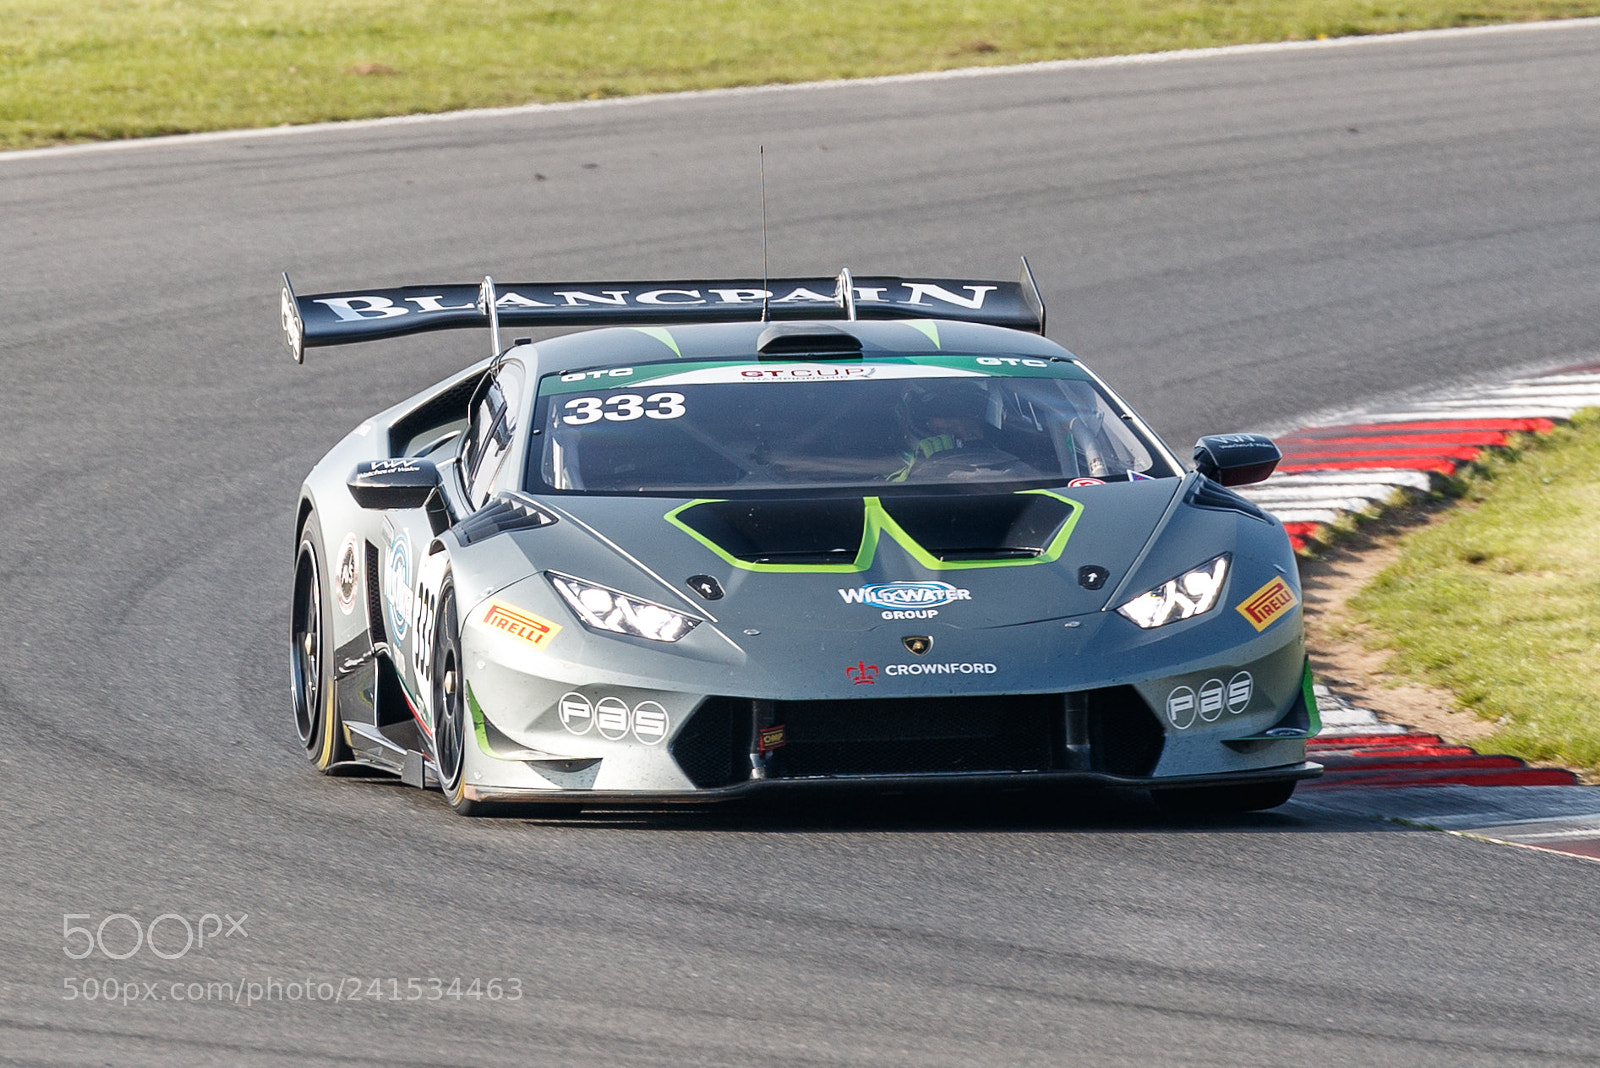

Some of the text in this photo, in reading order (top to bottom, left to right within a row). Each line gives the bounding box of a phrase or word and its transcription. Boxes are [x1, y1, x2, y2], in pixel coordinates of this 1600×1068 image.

[312, 282, 998, 323] BLANCPAIN
[977, 357, 1048, 367] GTC
[561, 368, 634, 382] GTC
[791, 368, 864, 377] CUP
[563, 392, 686, 425] 333
[838, 588, 972, 604] WILDWATER
[1245, 582, 1293, 624] PIRELLI
[881, 609, 939, 620] GROUP
[483, 604, 551, 644] PIRELLI
[885, 662, 998, 676] CROWNFORD
